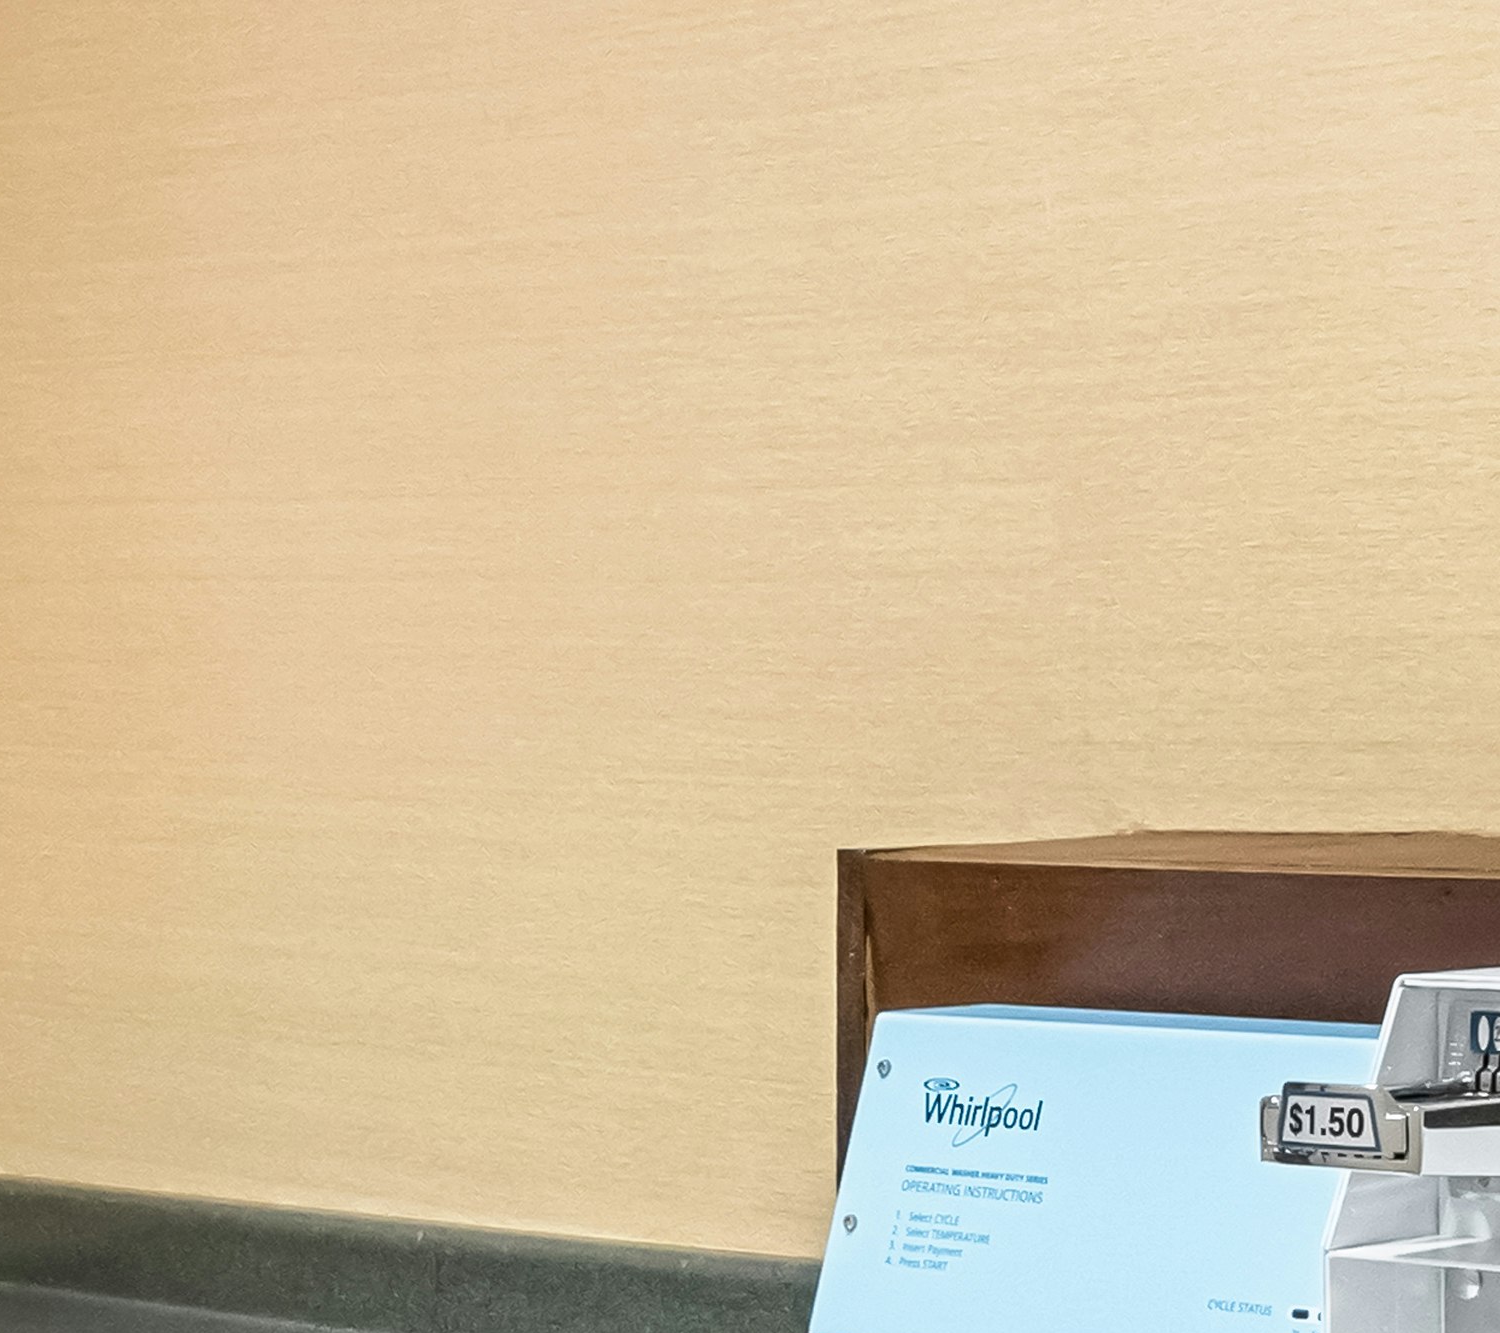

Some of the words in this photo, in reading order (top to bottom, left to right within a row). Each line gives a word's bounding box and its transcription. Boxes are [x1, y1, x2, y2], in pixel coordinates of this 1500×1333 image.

[925, 1092, 1043, 1137] Whirlpool
[1289, 1102, 1364, 1138] $1.50
[901, 1179, 961, 1197] OPERATING
[964, 1185, 1044, 1205] INSTRUCTIONS
